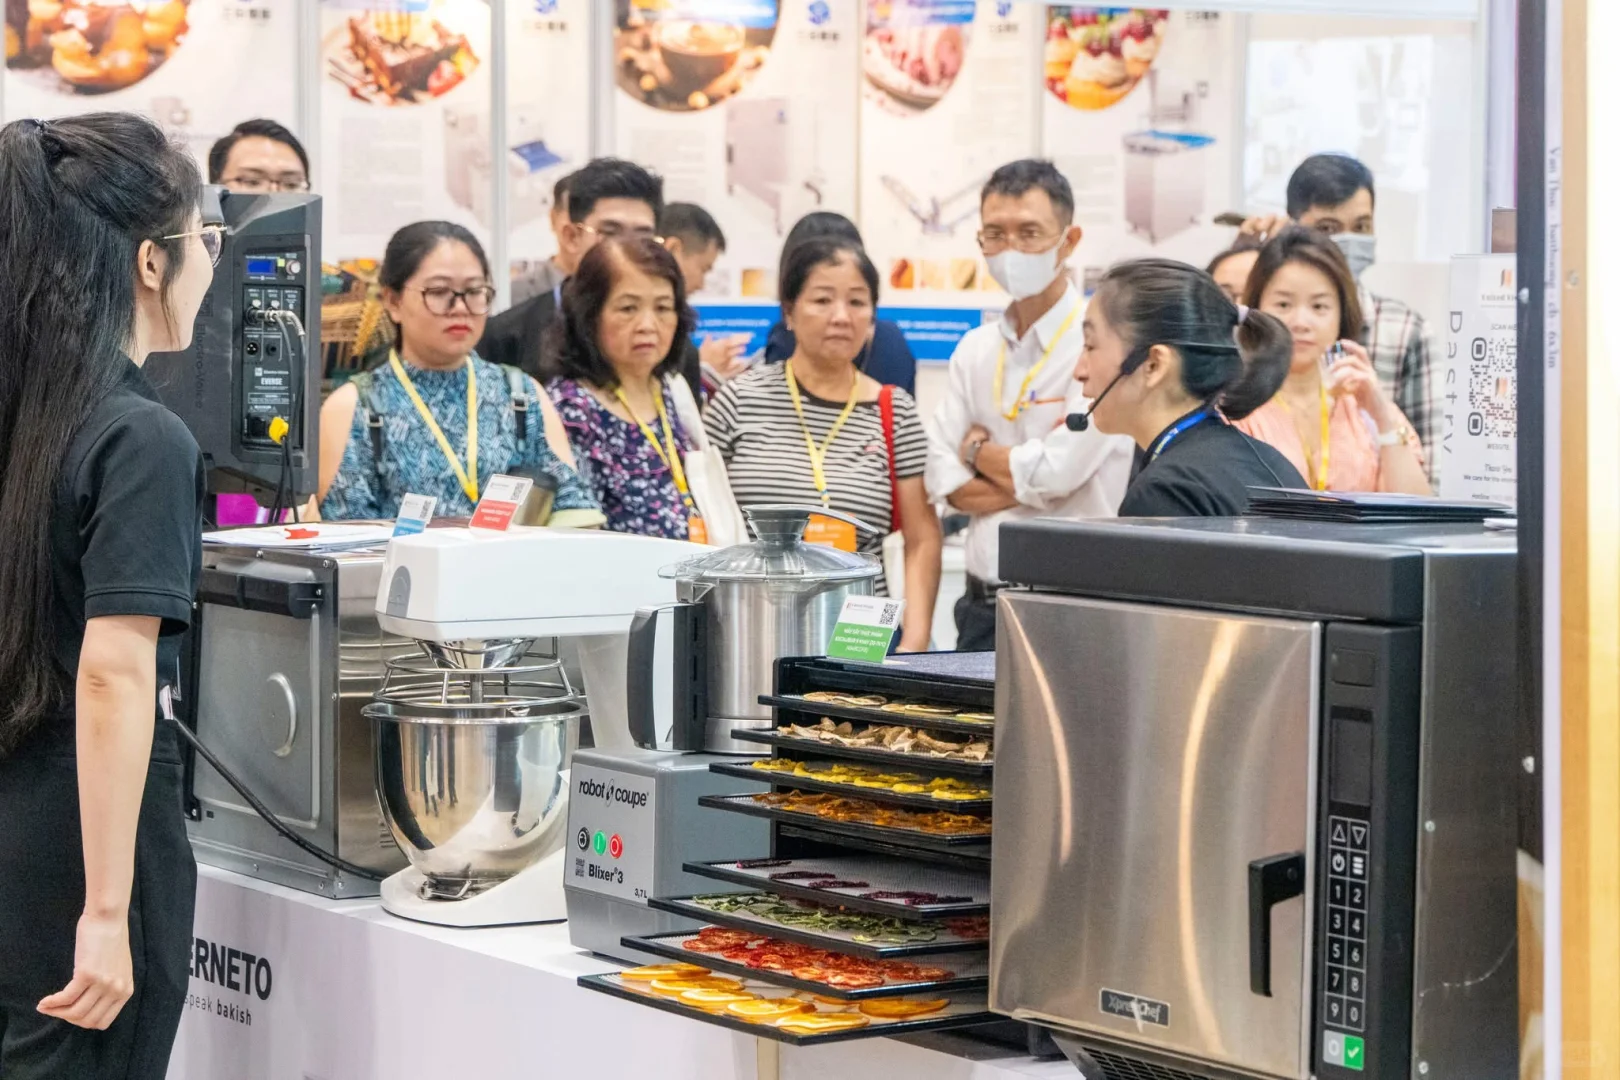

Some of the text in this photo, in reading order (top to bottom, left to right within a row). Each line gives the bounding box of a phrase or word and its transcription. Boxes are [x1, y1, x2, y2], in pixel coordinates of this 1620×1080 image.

[579, 779, 647, 809] robot coupe
[1335, 885, 1361, 903] 1 2
[1333, 914, 1360, 933] 3 4
[1332, 943, 1360, 963] 5 6
[189, 937, 272, 1001] RNETO
[1332, 973, 1359, 993] 7 8
[217, 999, 252, 1026] bakish
[1331, 1003, 1358, 1022] 9 0
